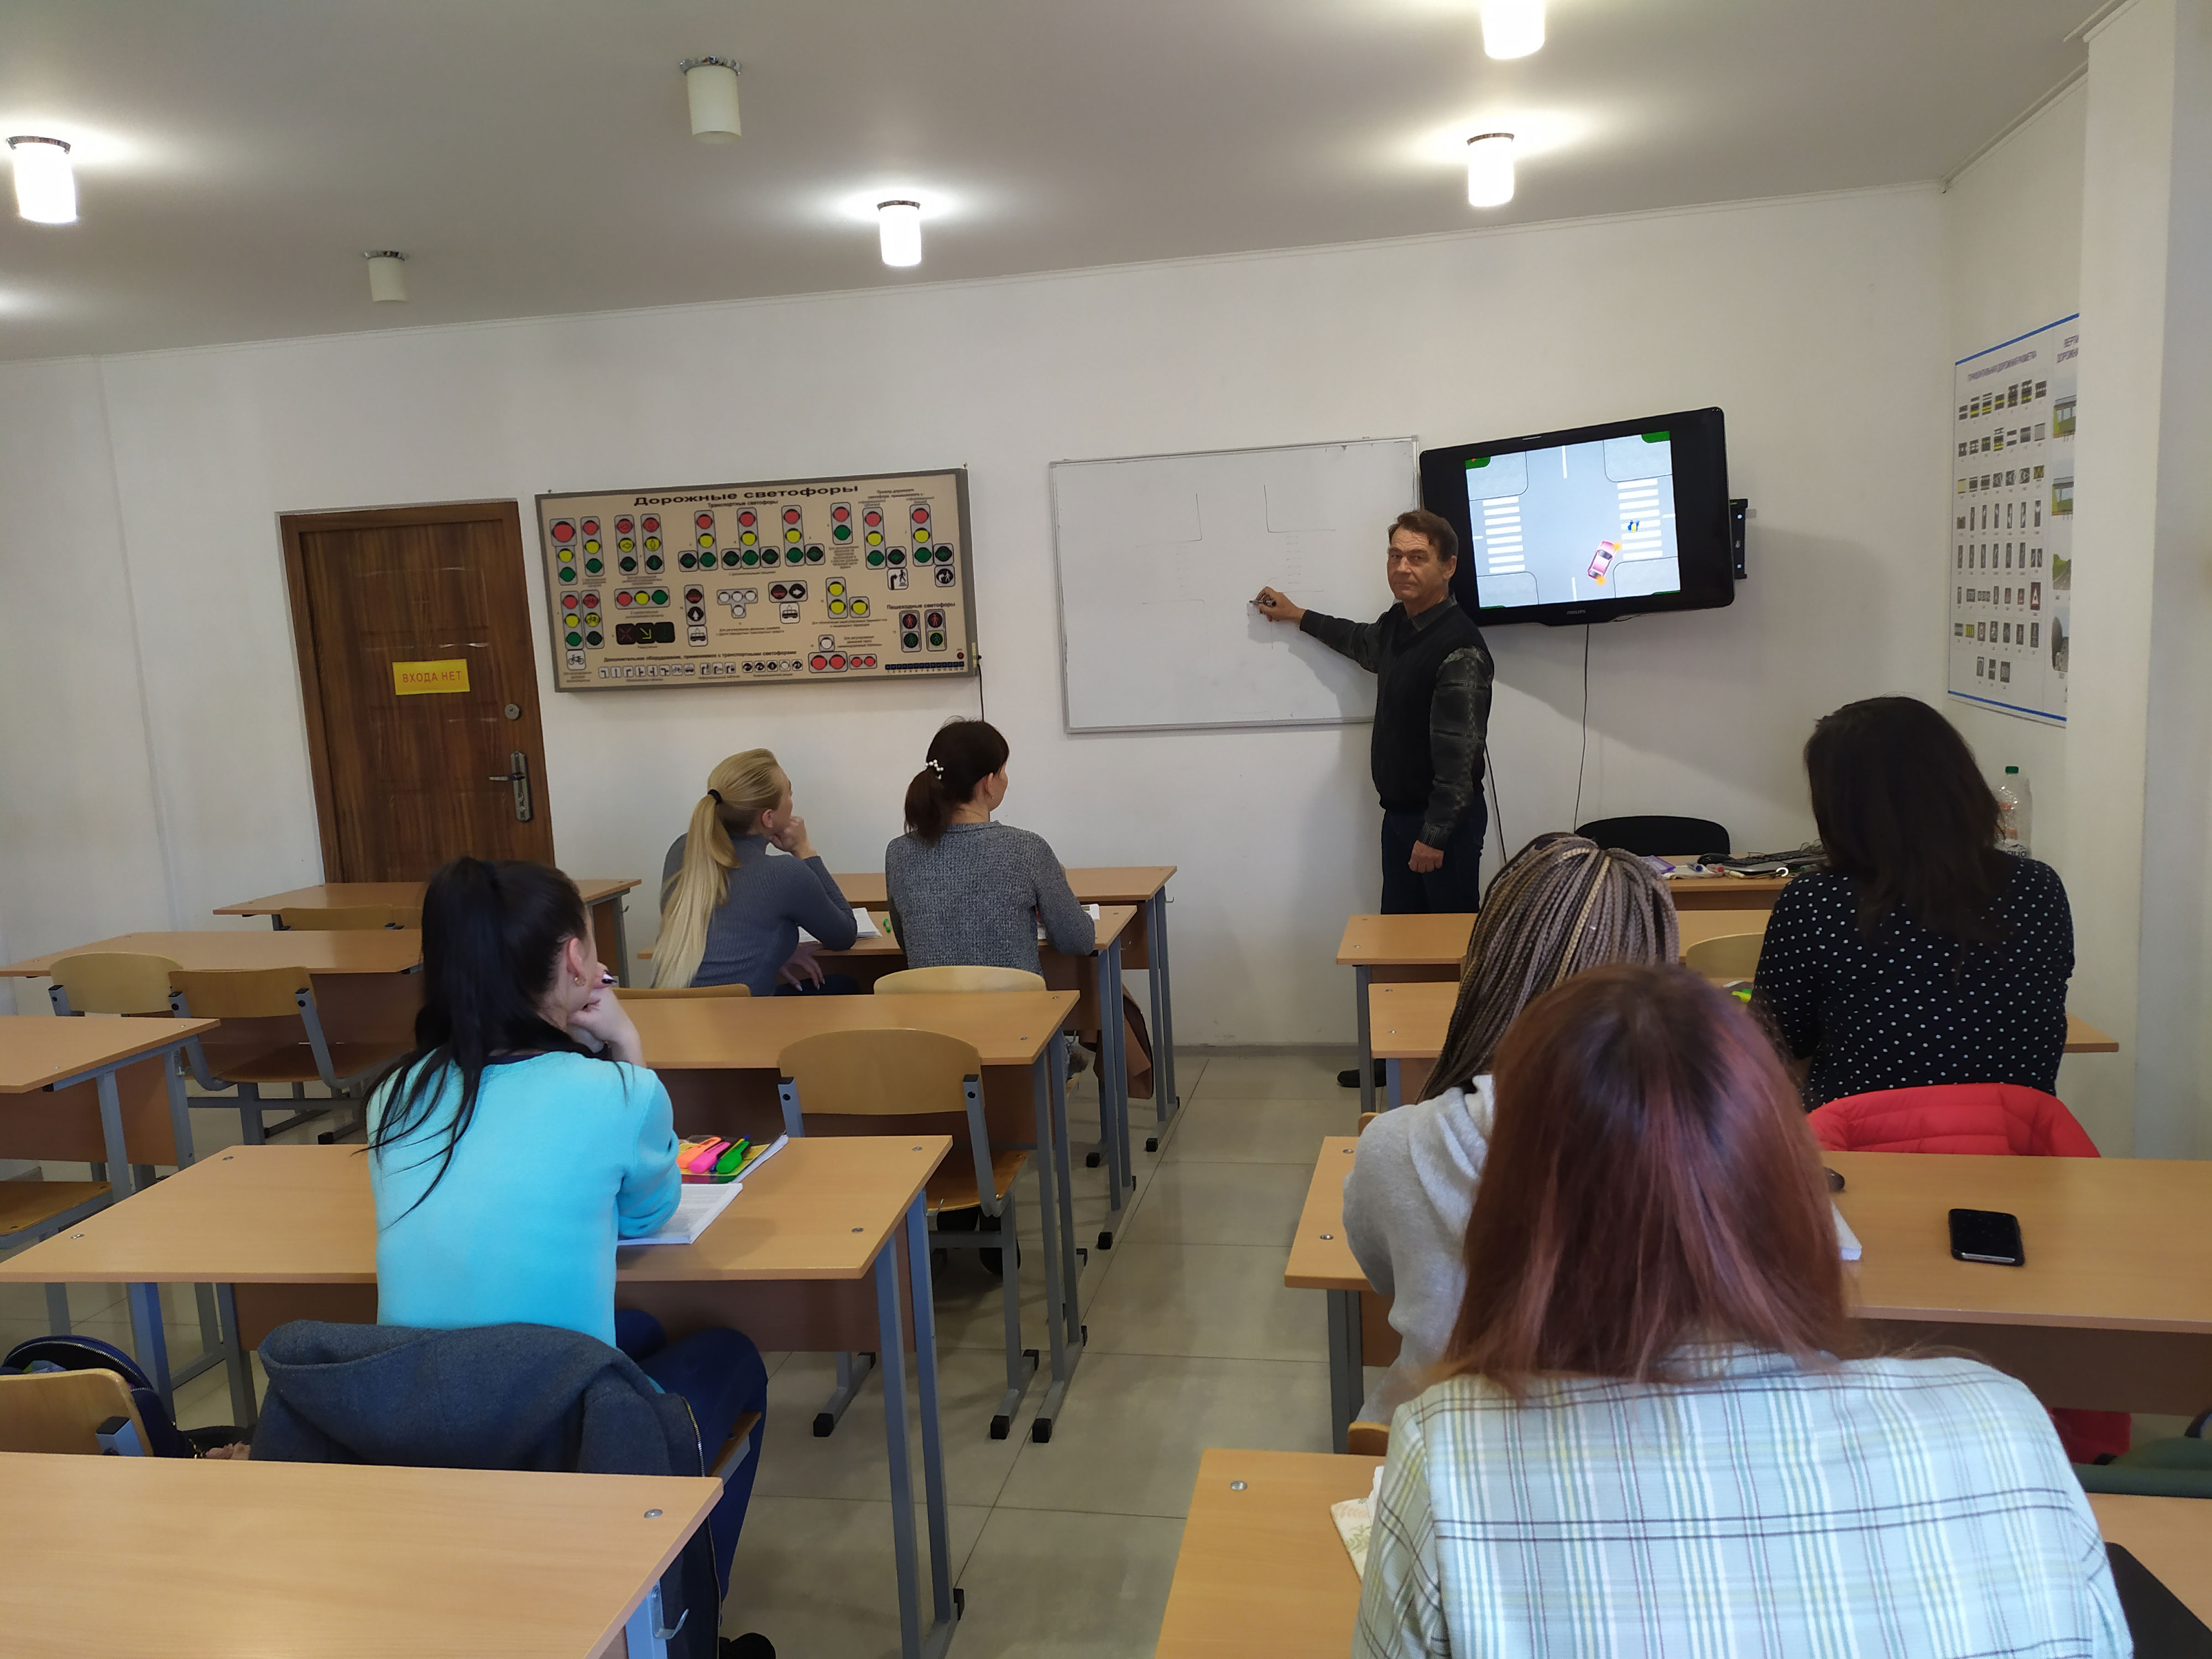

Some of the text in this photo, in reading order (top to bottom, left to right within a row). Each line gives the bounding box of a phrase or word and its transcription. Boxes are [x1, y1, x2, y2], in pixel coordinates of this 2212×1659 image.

[634, 485, 858, 506] Дорожные светофоры
[403, 671, 461, 684] ВХОДА НЕТ
